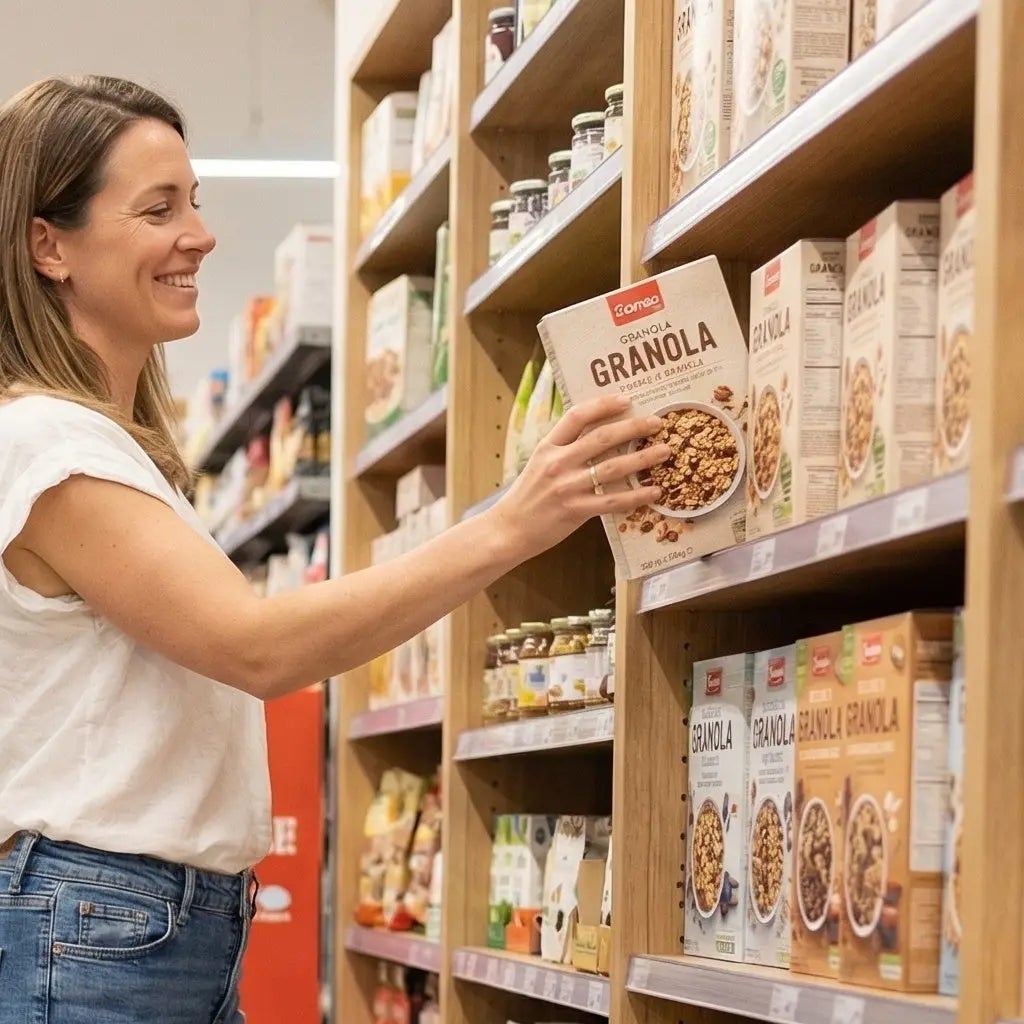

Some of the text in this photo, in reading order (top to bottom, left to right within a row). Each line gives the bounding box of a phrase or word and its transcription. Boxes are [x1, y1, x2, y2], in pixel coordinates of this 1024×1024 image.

[590, 321, 718, 388] GRANOLA
[753, 713, 795, 750] GRANOLA
[847, 697, 900, 737] GRANOLA
[692, 720, 733, 753] GRANOLA
